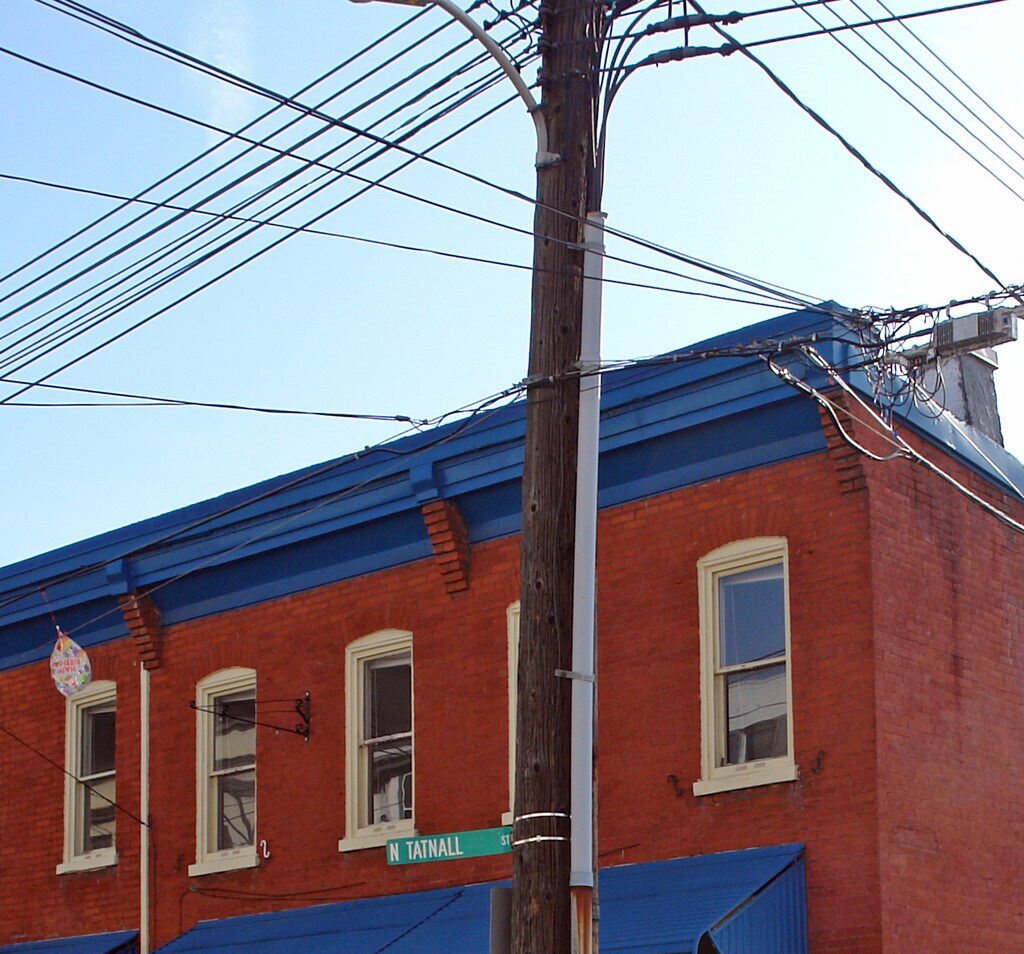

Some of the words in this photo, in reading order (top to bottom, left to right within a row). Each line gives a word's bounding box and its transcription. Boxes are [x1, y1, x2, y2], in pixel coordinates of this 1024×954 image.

[389, 842, 399, 862] N
[406, 836, 464, 860] TATNALL
[501, 834, 511, 846] ST
